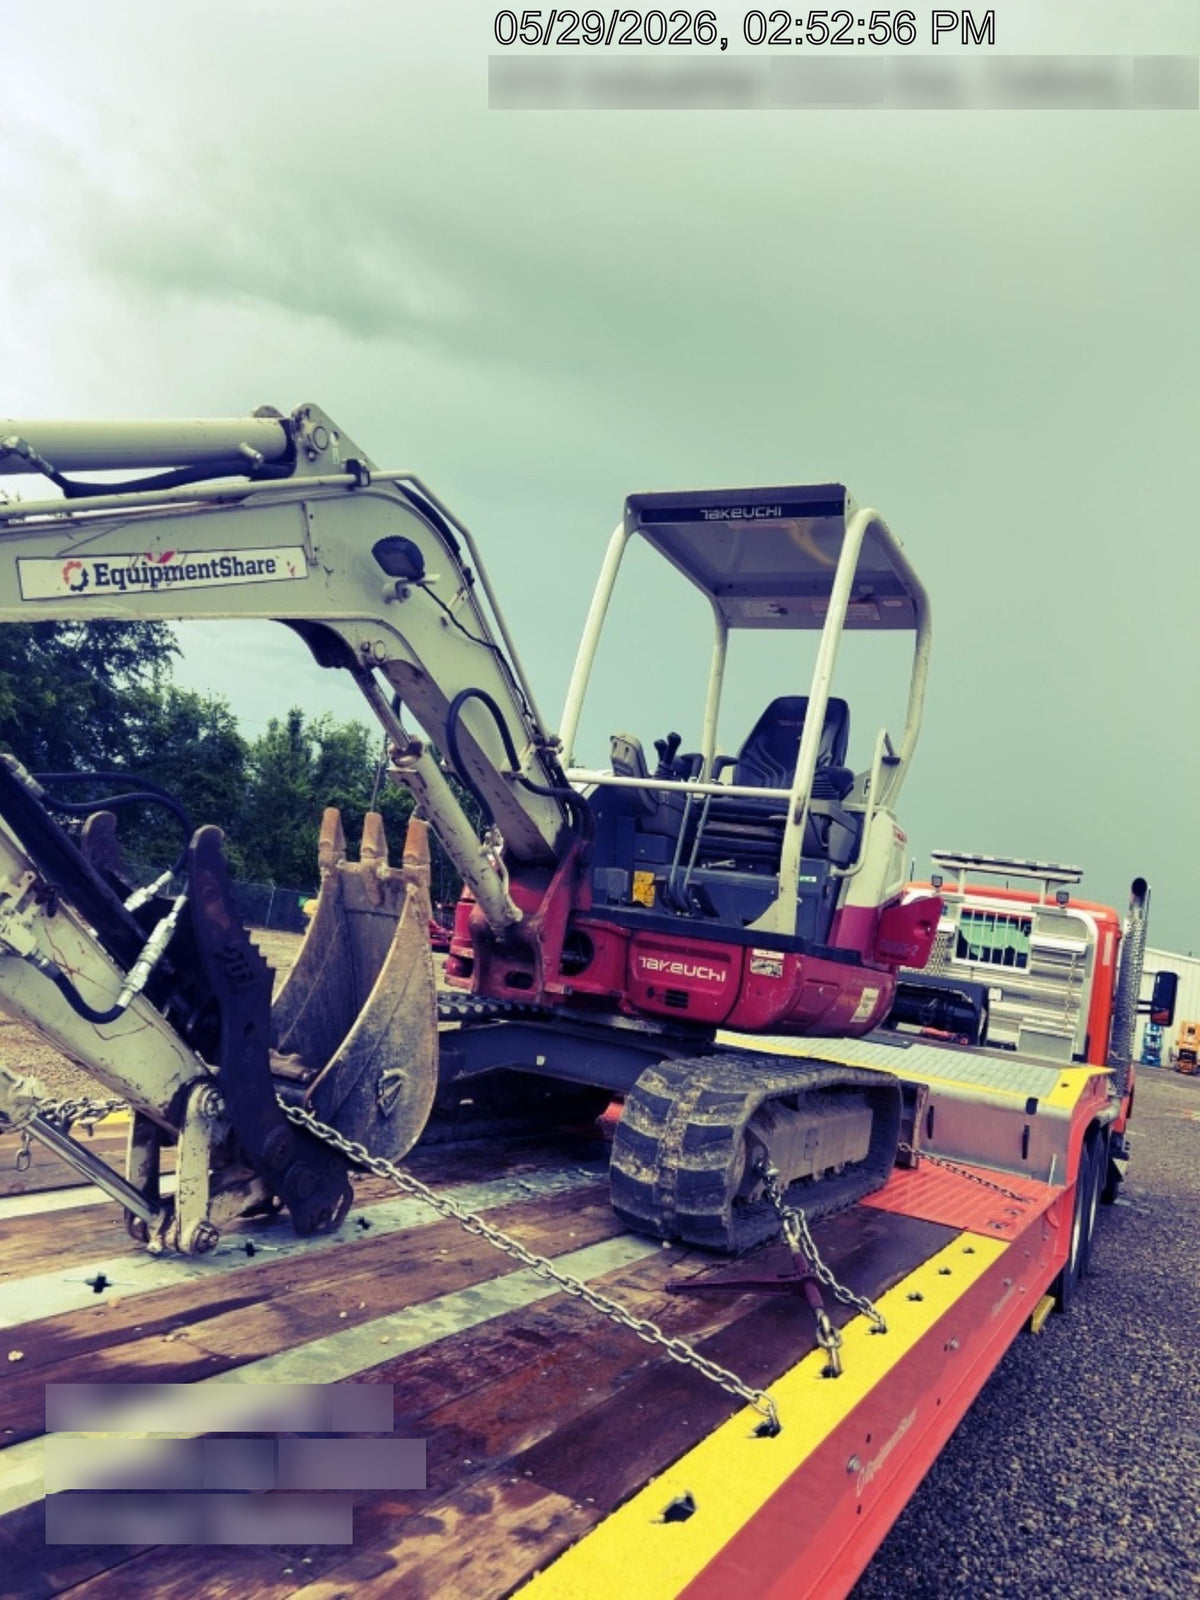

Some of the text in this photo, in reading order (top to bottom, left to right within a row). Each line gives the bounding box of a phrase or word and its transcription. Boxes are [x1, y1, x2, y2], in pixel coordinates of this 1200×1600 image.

[701, 506, 782, 520] TAKEUCHI
[93, 557, 276, 590] EquipmentShare
[638, 957, 727, 982] TAKEUCHI
